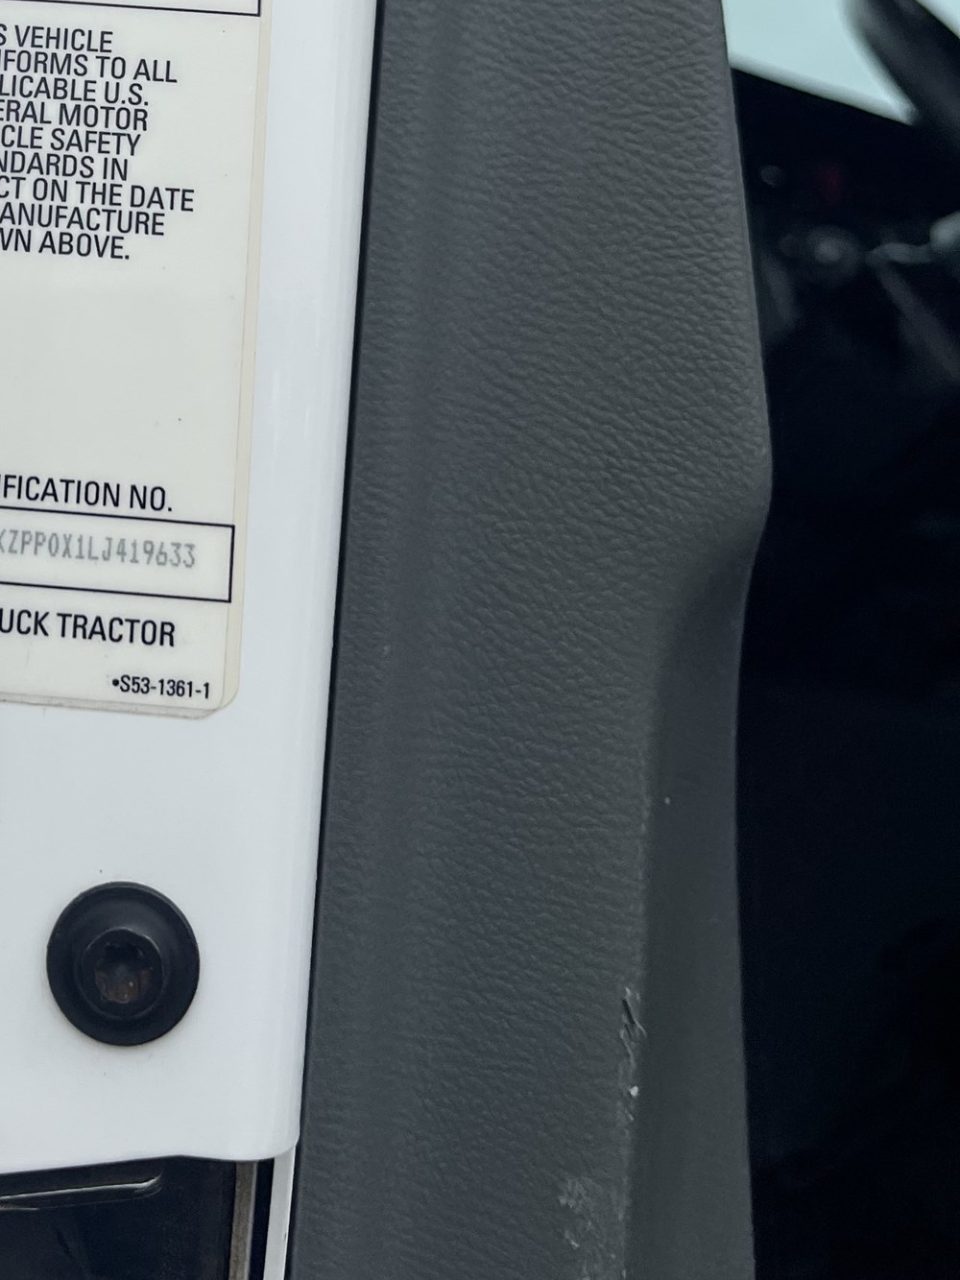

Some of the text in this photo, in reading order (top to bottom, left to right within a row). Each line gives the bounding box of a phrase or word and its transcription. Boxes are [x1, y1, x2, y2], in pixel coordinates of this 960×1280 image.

[14, 25, 113, 53] VEHICLE
[95, 55, 127, 79] TO
[133, 59, 178, 83] ALL
[103, 81, 149, 106] U.S.
[58, 103, 149, 131] MOTOR
[50, 128, 141, 156] SAFETY
[102, 157, 128, 181] IN
[32, 177, 68, 202] ON
[75, 180, 123, 206] THE
[130, 185, 195, 212] DATE
[38, 230, 130, 260] ABOVE.
[129, 484, 173, 512] NO.
[57, 612, 176, 647] TRACTOR
